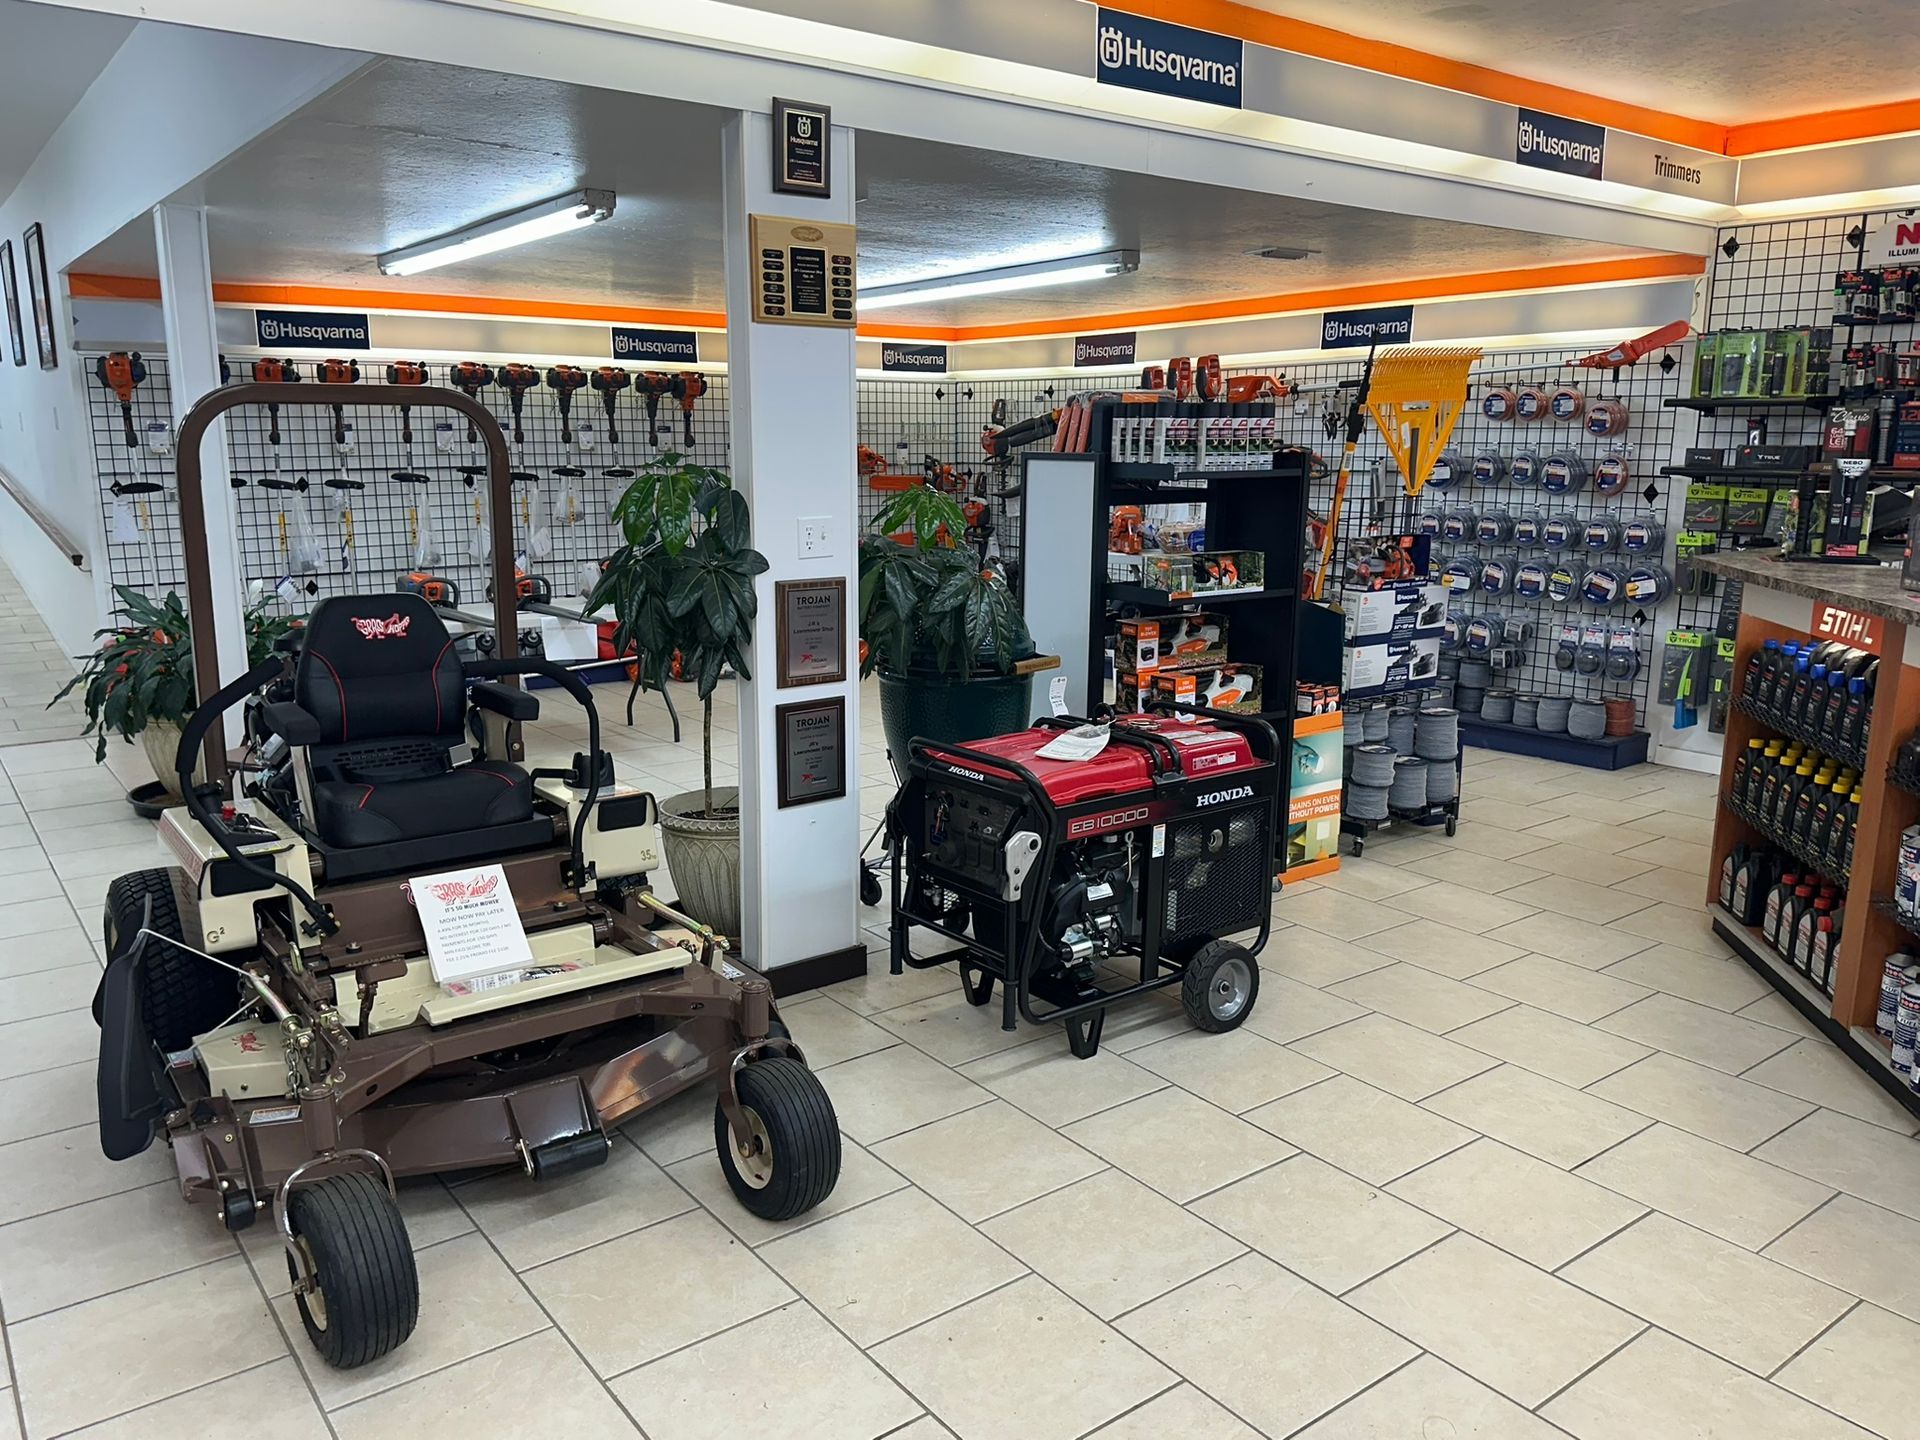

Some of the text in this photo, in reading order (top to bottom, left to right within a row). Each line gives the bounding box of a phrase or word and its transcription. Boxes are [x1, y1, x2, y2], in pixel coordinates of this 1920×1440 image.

[1125, 37, 1236, 87] Husqvarna
[790, 135, 818, 146] Husqvarna
[1533, 128, 1600, 164] Husqvarna
[1654, 154, 1701, 185] Trimmers
[280, 322, 365, 341] Husqvarna
[1339, 320, 1408, 337] Husqvarna
[629, 338, 693, 354] Husqvarna
[1086, 343, 1133, 357] Husqvarna
[894, 352, 944, 366] Husqvarna
[1832, 410, 1870, 422] Classic
[796, 595, 831, 605] TROJAN
[1819, 606, 1873, 645] STIHL
[796, 716, 830, 728] TROJAN
[948, 765, 985, 781] HONDA
[1196, 786, 1254, 807] HONDA
[1312, 798, 1322, 807] ON
[1322, 795, 1340, 805] EVEN
[1314, 803, 1339, 815] POWER
[1071, 807, 1149, 834] EB10000
